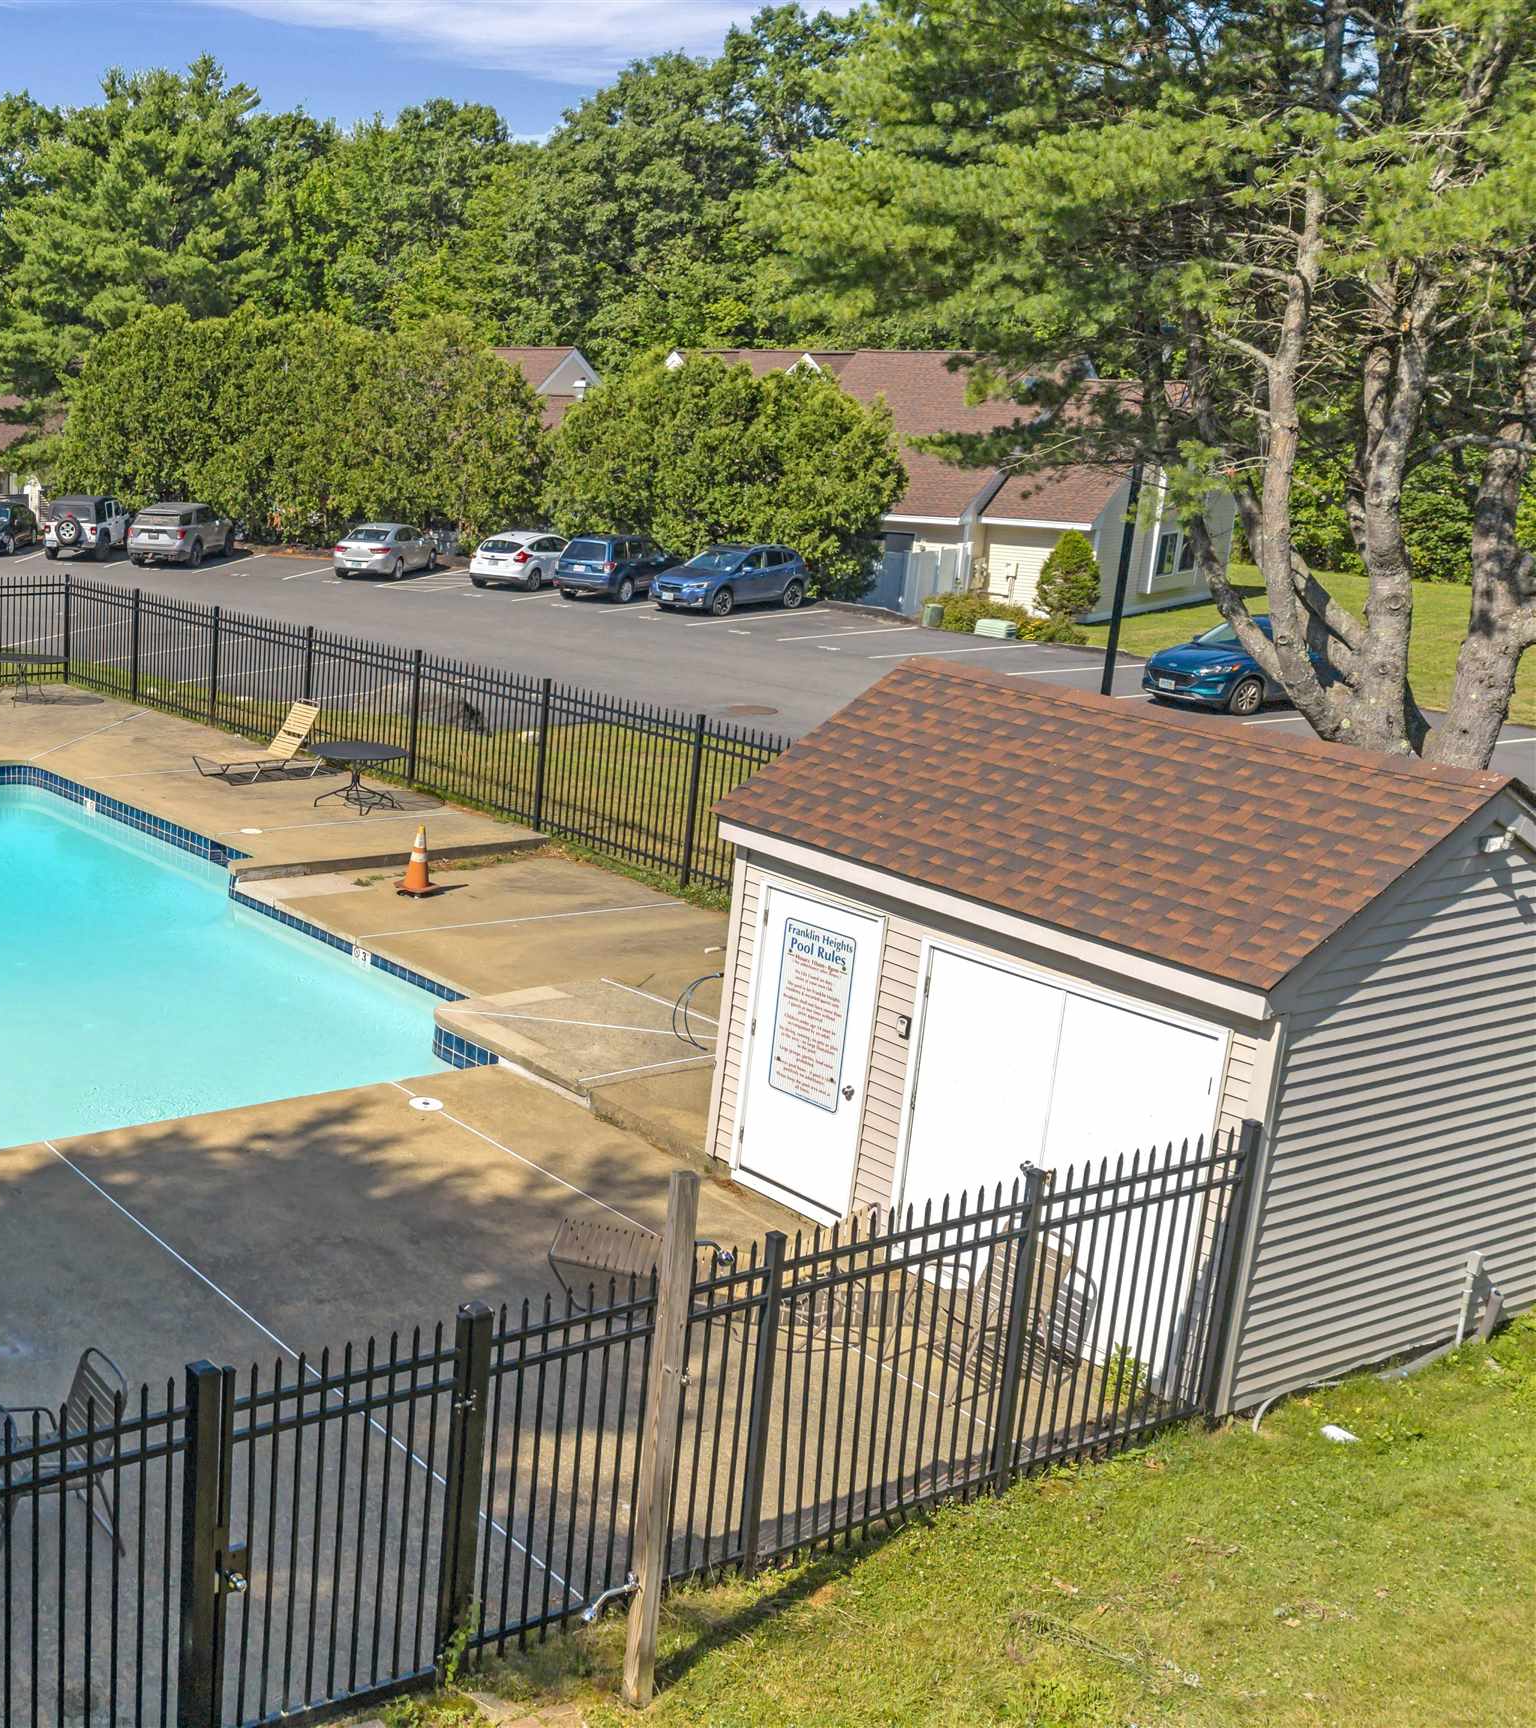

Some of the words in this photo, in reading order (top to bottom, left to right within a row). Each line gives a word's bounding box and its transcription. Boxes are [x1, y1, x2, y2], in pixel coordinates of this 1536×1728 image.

[788, 923, 820, 942] Franklin
[822, 935, 853, 953] Heights
[791, 937, 814, 955] Pool
[817, 946, 846, 966] Rules
